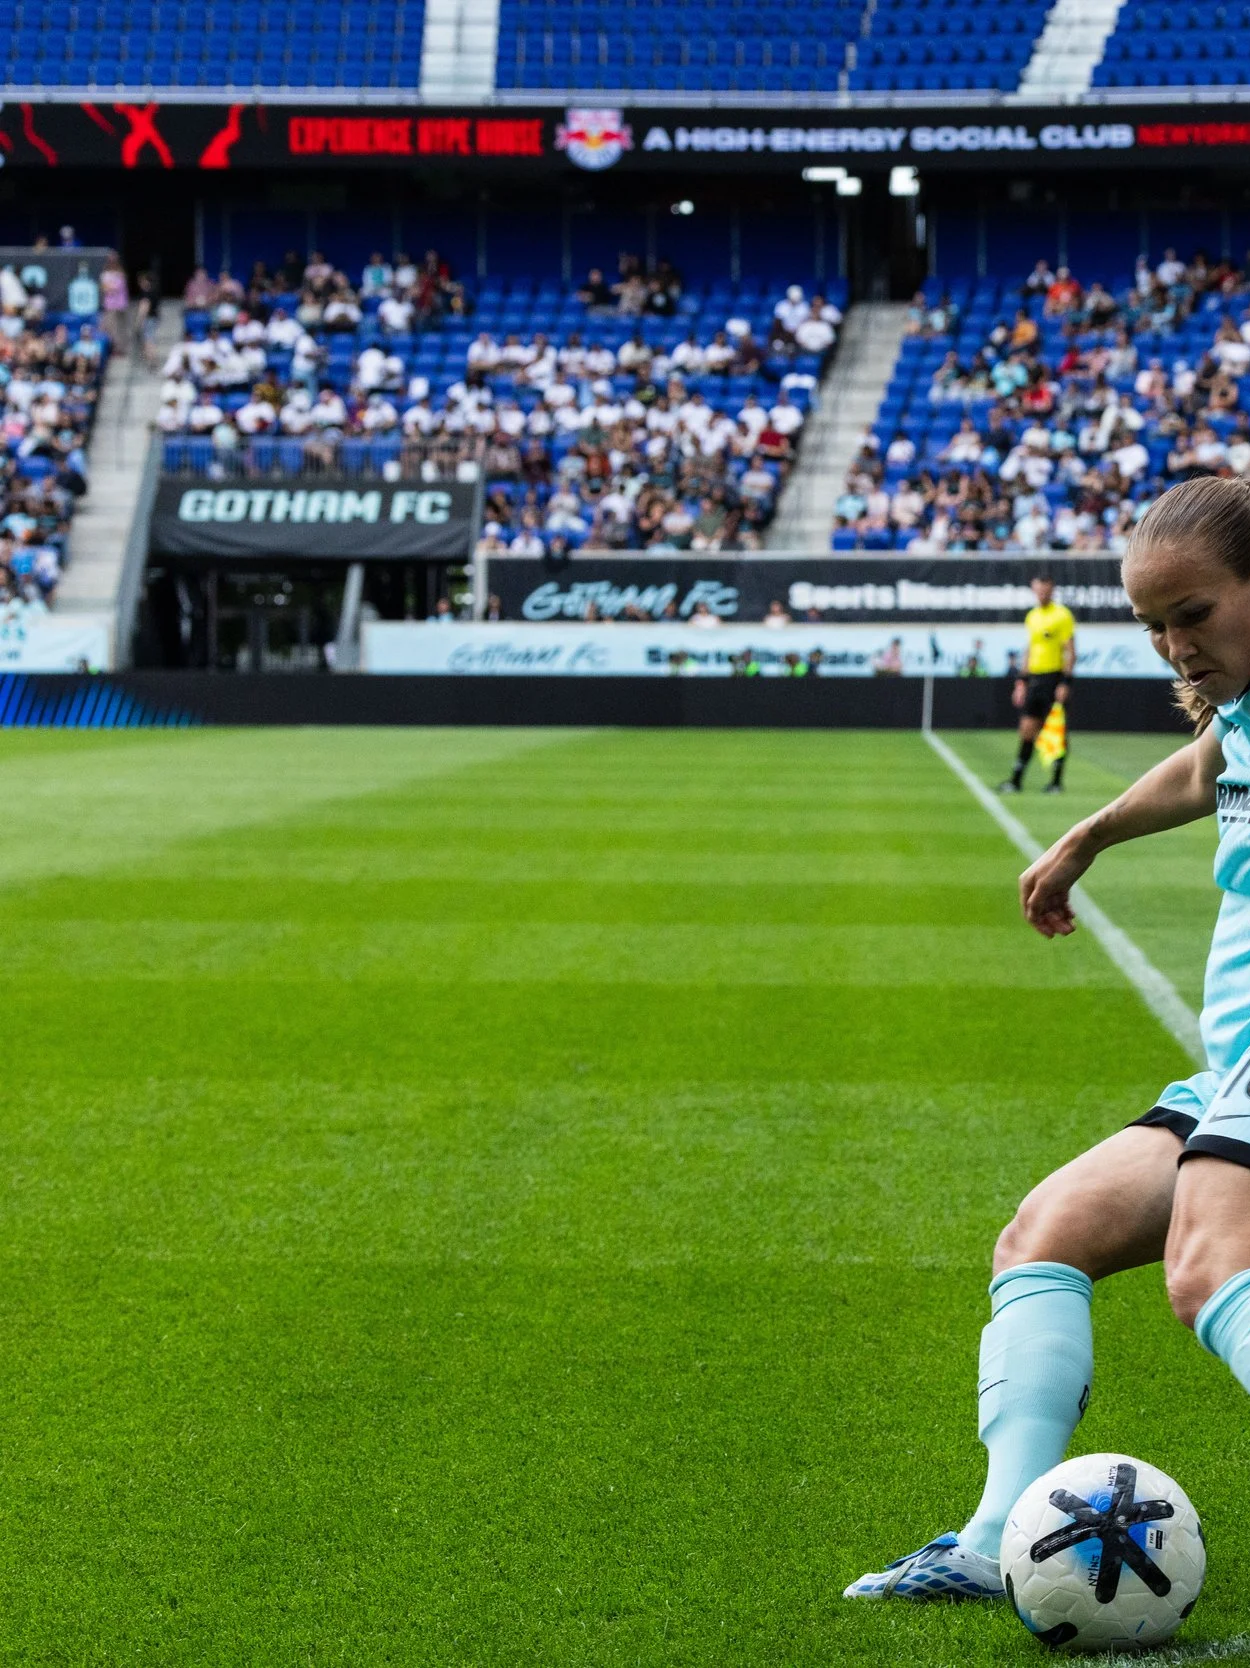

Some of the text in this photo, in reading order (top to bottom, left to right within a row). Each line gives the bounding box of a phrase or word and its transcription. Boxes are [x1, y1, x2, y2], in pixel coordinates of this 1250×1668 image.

[288, 117, 412, 155] EXPERIENCE
[417, 118, 472, 156] HYPE
[642, 126, 673, 151] A
[910, 126, 1037, 151] SOCIAL
[1040, 125, 1134, 150] CLUB
[178, 489, 452, 524] GOTHAM FC
[679, 579, 740, 617] FC
